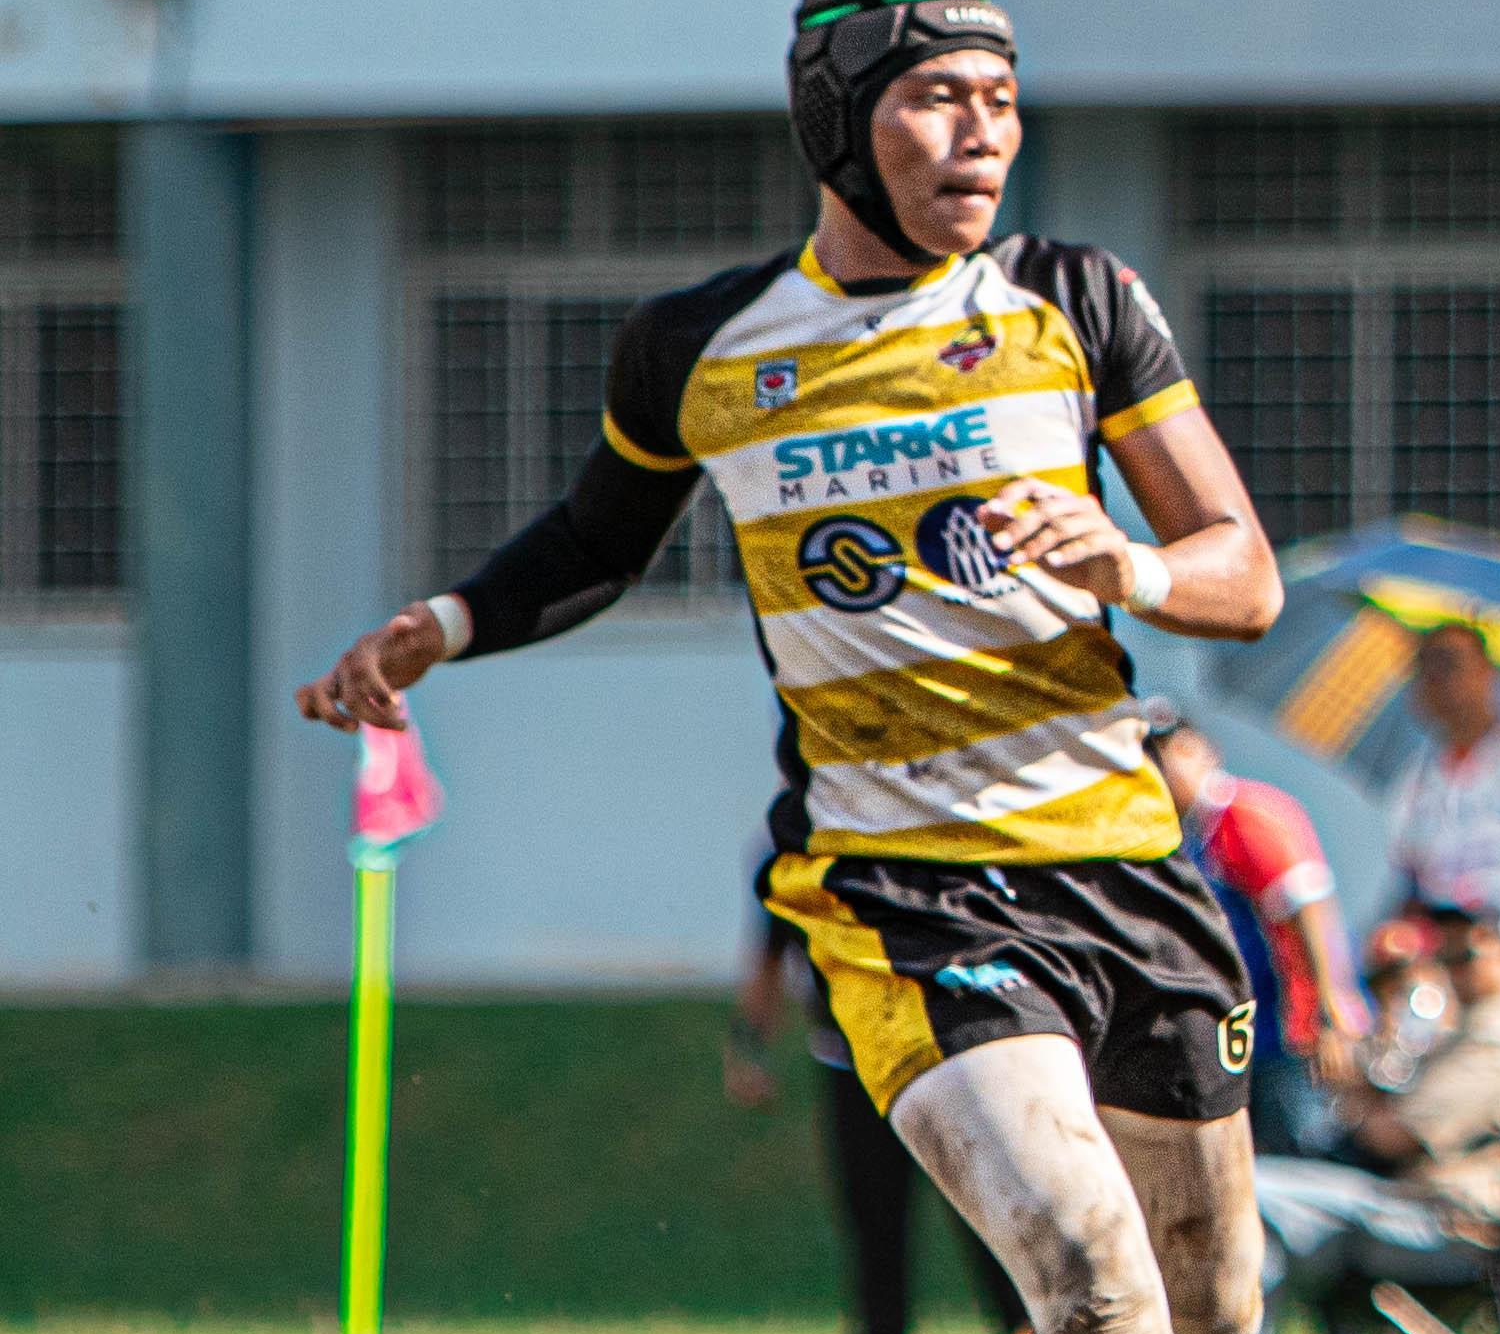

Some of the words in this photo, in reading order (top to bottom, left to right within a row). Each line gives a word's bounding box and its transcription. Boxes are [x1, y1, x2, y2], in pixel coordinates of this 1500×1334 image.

[773, 405, 993, 482] STARKE
[778, 446, 1000, 506] MARINE
[1217, 998, 1257, 1075] 6
